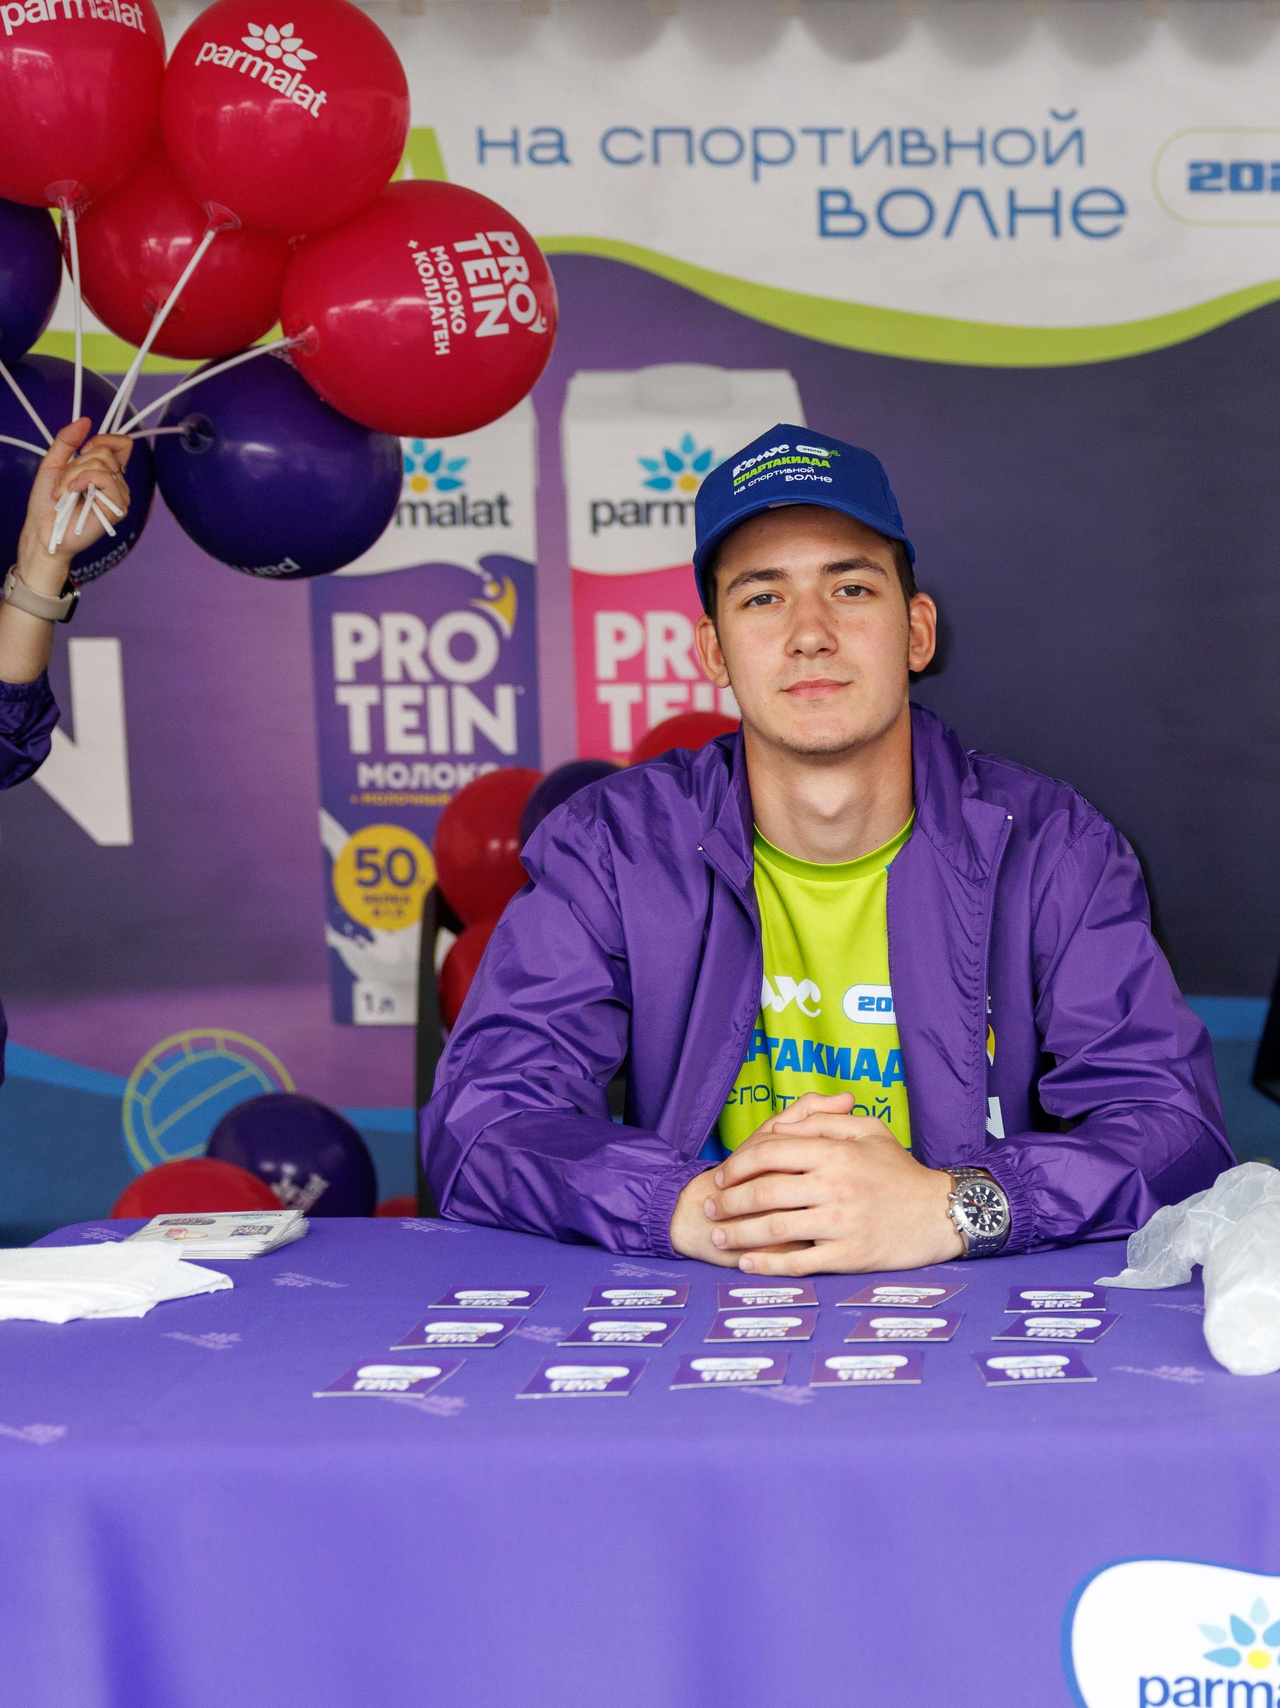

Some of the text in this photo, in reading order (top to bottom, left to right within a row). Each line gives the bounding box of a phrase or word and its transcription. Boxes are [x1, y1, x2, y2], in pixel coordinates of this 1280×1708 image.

[195, 41, 328, 118] parmalat
[477, 126, 572, 165] на
[599, 107, 1086, 183] спортивной
[816, 186, 1129, 239] волне
[411, 250, 451, 356] КОЛЛАГЕН
[430, 245, 467, 335] МОЛОКО
[453, 232, 510, 338] TEIN
[485, 231, 537, 324] PRO
[733, 456, 831, 487] СПАРТАКИАДА
[747, 467, 815, 487] спортивной
[395, 493, 513, 529] malat
[591, 499, 698, 535] parm
[332, 610, 499, 684] PRO
[594, 611, 700, 681] PR
[335, 684, 518, 755] TEIN
[357, 761, 497, 790] МОЛОК
[355, 846, 418, 888] 50
[857, 995, 894, 1013] 20
[744, 1028, 907, 1088] РТАКИАД
